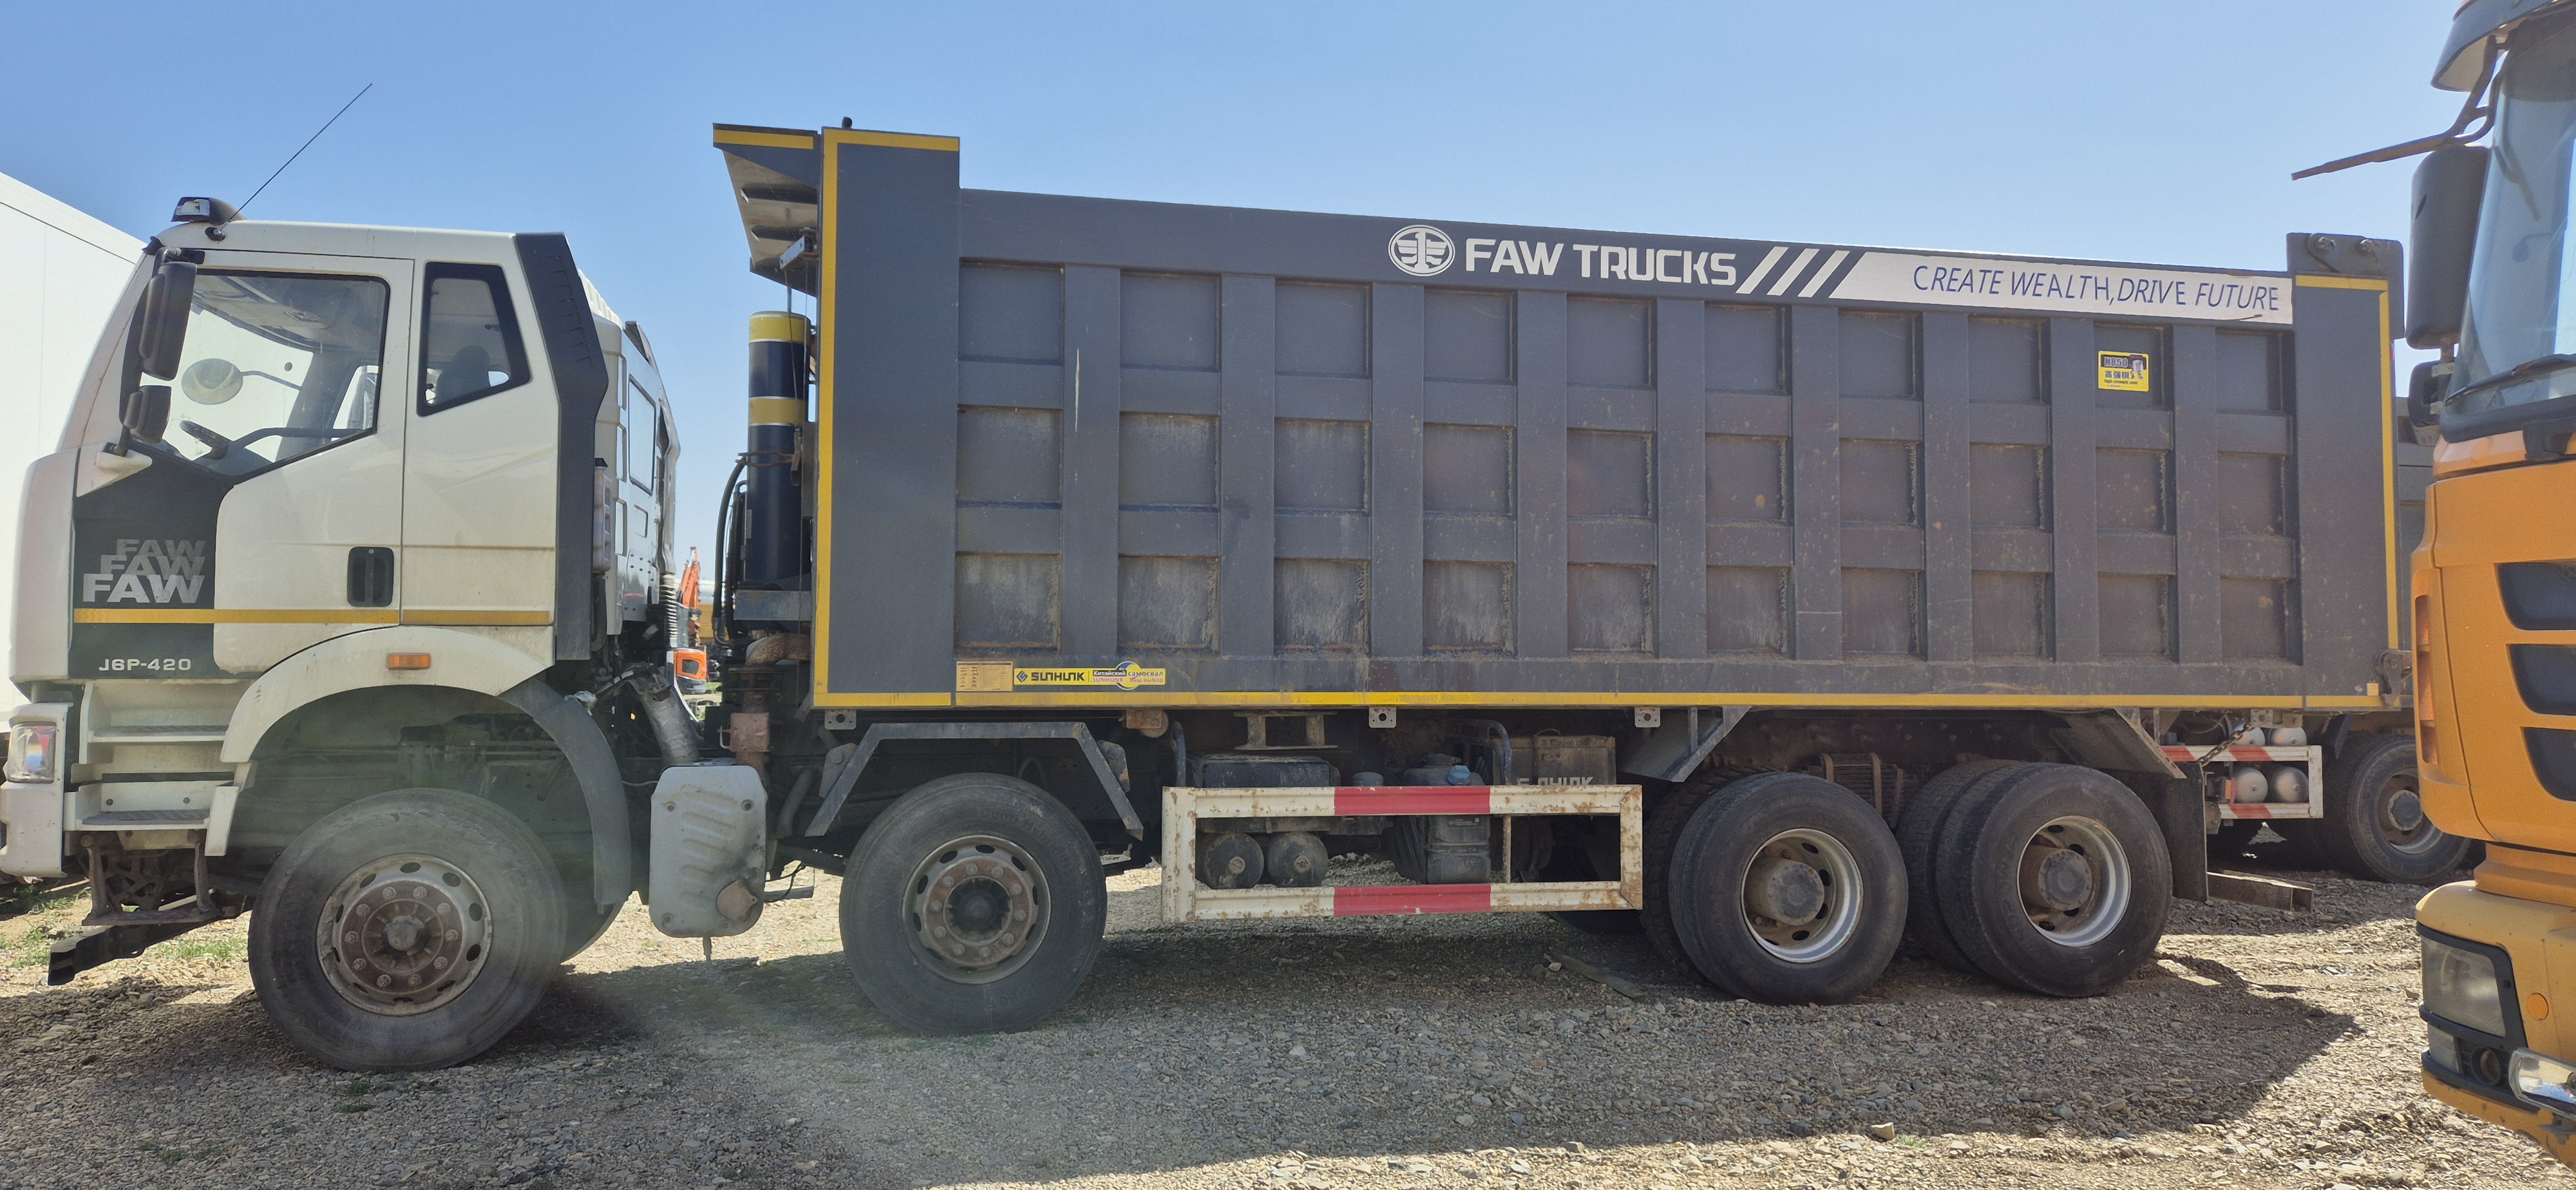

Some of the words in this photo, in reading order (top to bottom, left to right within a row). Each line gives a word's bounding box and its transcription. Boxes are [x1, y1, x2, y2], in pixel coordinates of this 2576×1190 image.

[1465, 238, 1564, 276] FAW
[1573, 244, 1737, 286] TRUCKS
[1913, 265, 2004, 294] CREATE
[2195, 282, 2279, 311] FUTURE
[2104, 356, 2128, 368] H850
[117, 538, 206, 561] FAW
[100, 554, 205, 581] FAW
[82, 573, 205, 603] FAW
[99, 658, 191, 671] J6P-420
[1031, 672, 1085, 681] SUNHUNK
